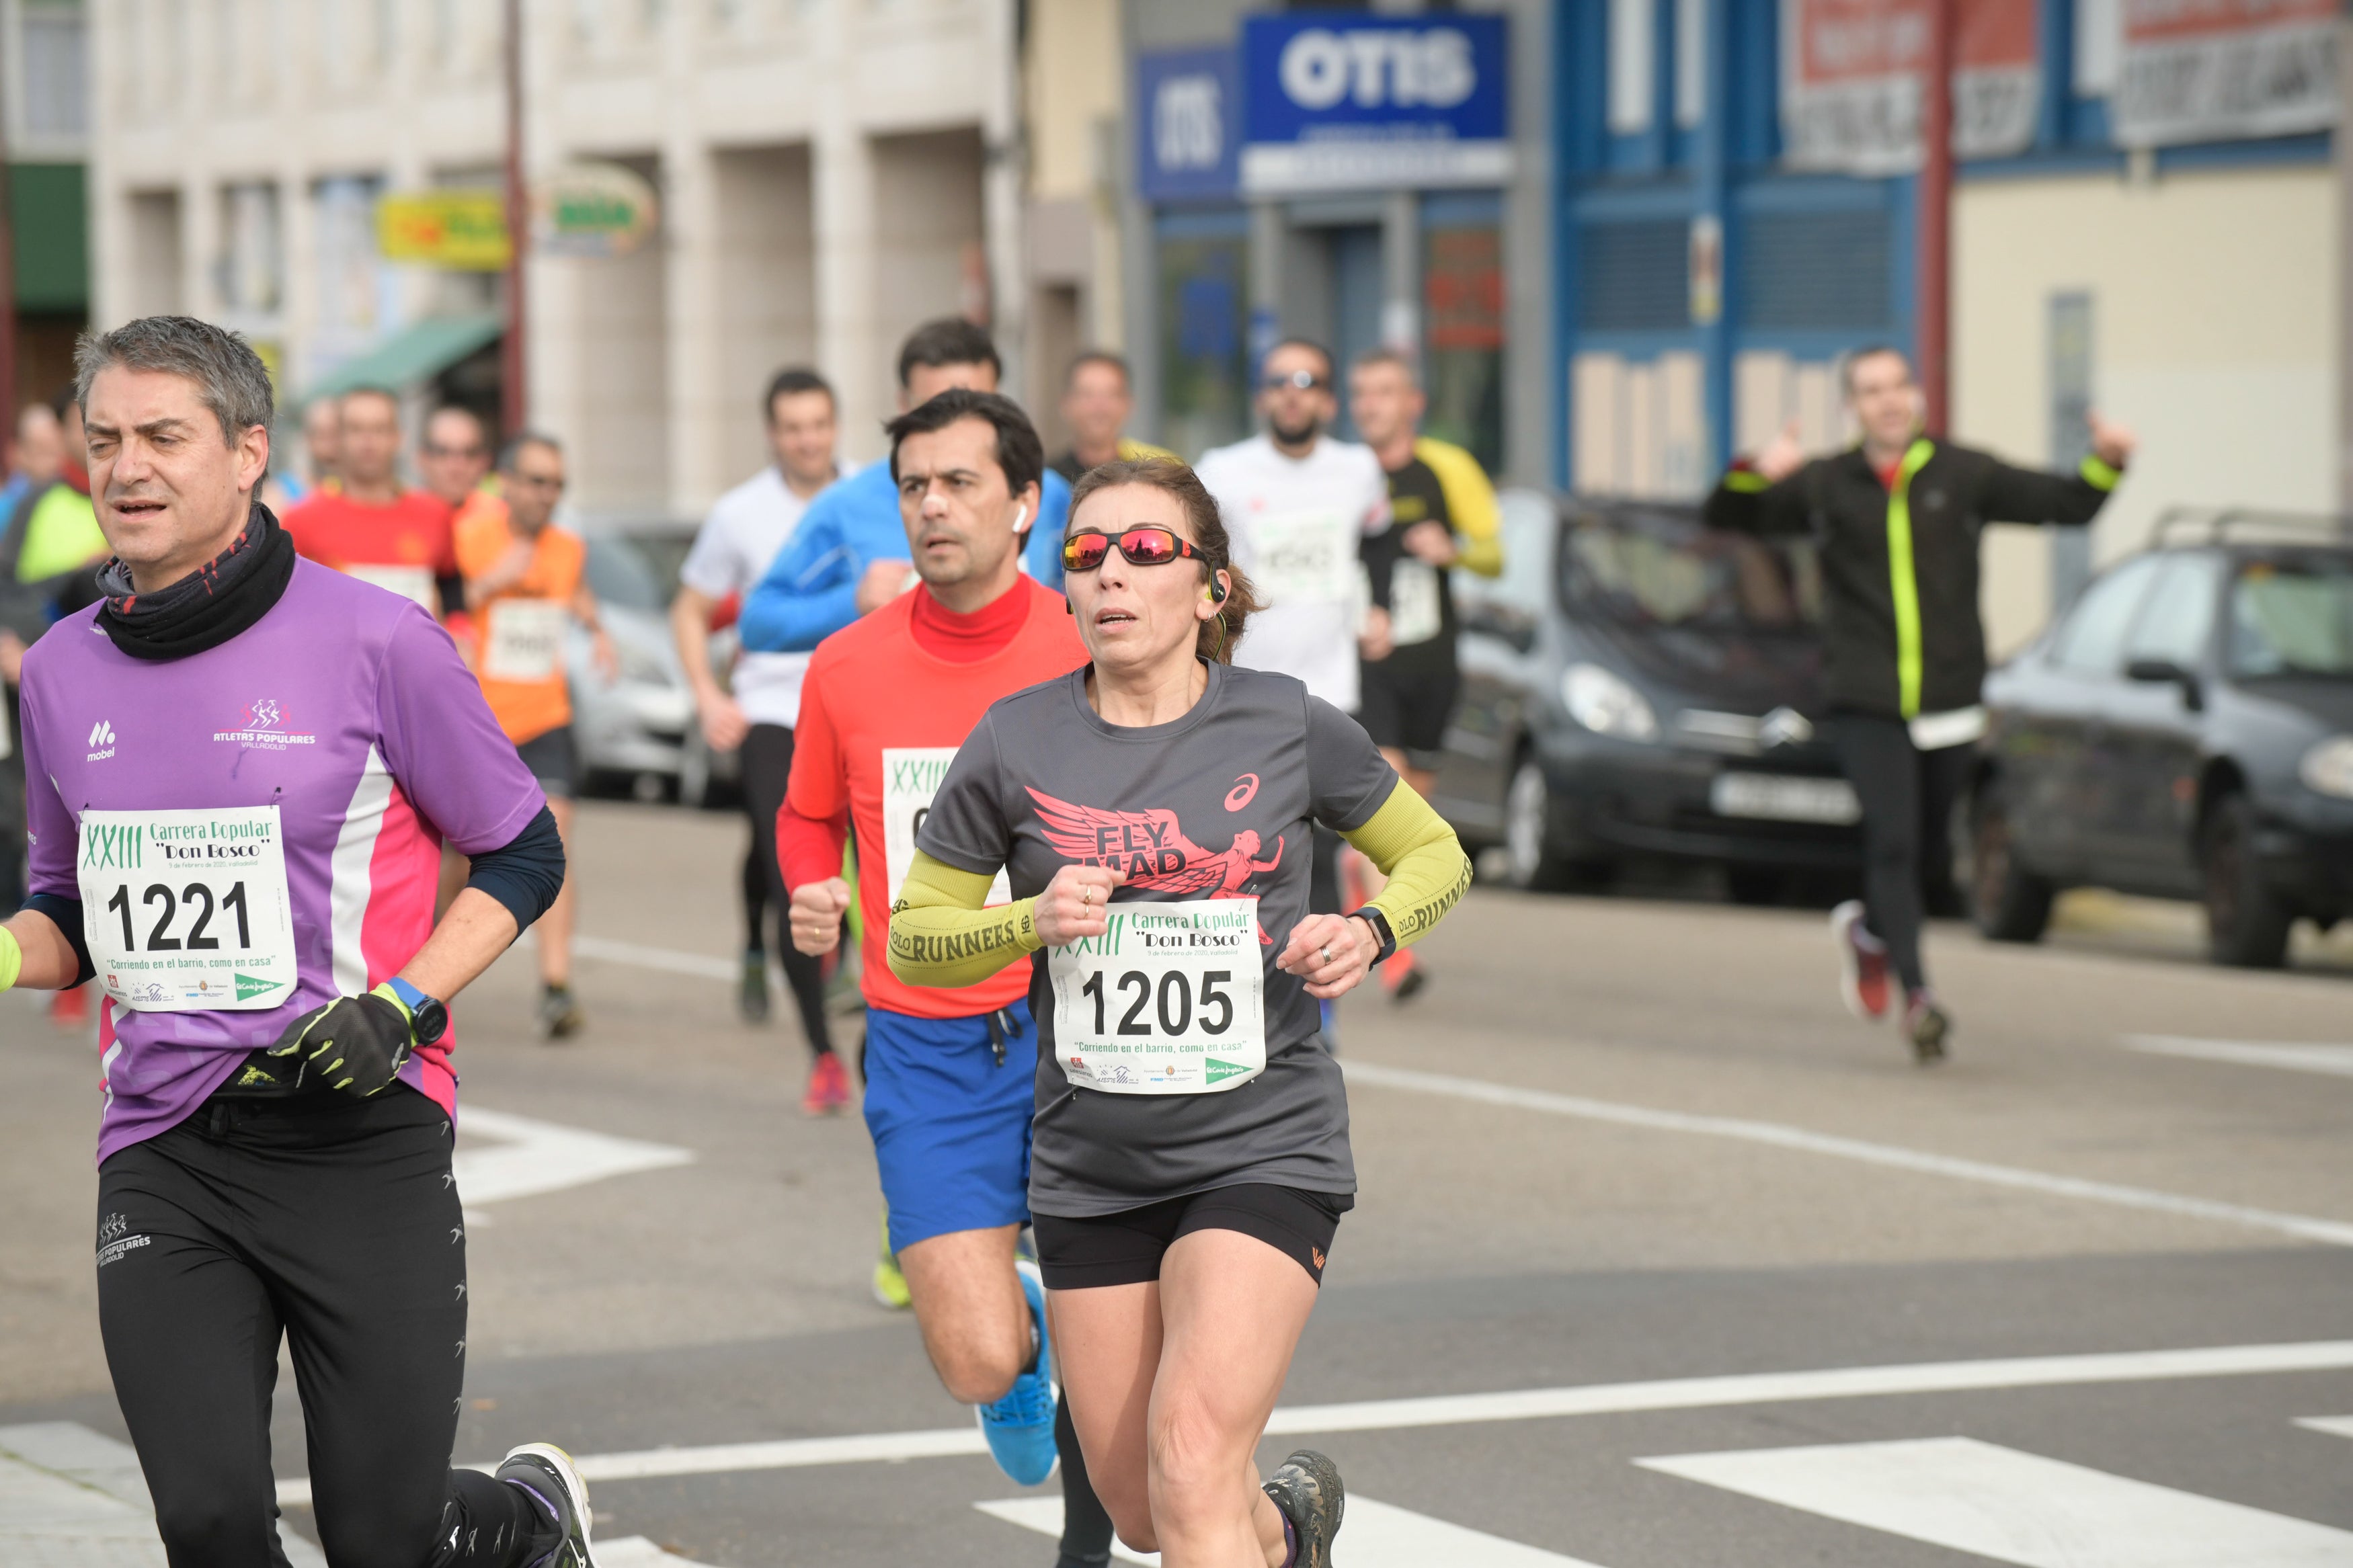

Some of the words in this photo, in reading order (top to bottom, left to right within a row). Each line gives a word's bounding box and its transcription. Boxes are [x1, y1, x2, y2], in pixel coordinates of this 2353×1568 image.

[1279, 28, 1475, 109] OTIS
[214, 733, 254, 741] ATLETAS
[257, 733, 315, 744] POPULARES
[241, 742, 286, 751] VALLADOLID
[87, 747, 115, 762] mobel
[150, 823, 206, 840] Carrera
[211, 820, 272, 841] Popular
[1096, 821, 1168, 855] FLY
[83, 823, 142, 872] XXIII
[1399, 915, 1415, 932] OLO
[1414, 856, 1473, 930] RUNNER
[108, 881, 251, 951] 1221
[1131, 912, 1189, 929] Carrera
[1194, 911, 1249, 932] Popular
[913, 919, 1015, 962] RUNNERS
[167, 958, 175, 968] el
[179, 958, 206, 968] barrio,
[210, 959, 232, 967] como
[1082, 970, 1233, 1036] 1205
[1135, 1044, 1142, 1053] el
[1146, 1043, 1176, 1054] barrio,
[105, 1237, 151, 1257] POPULARES
